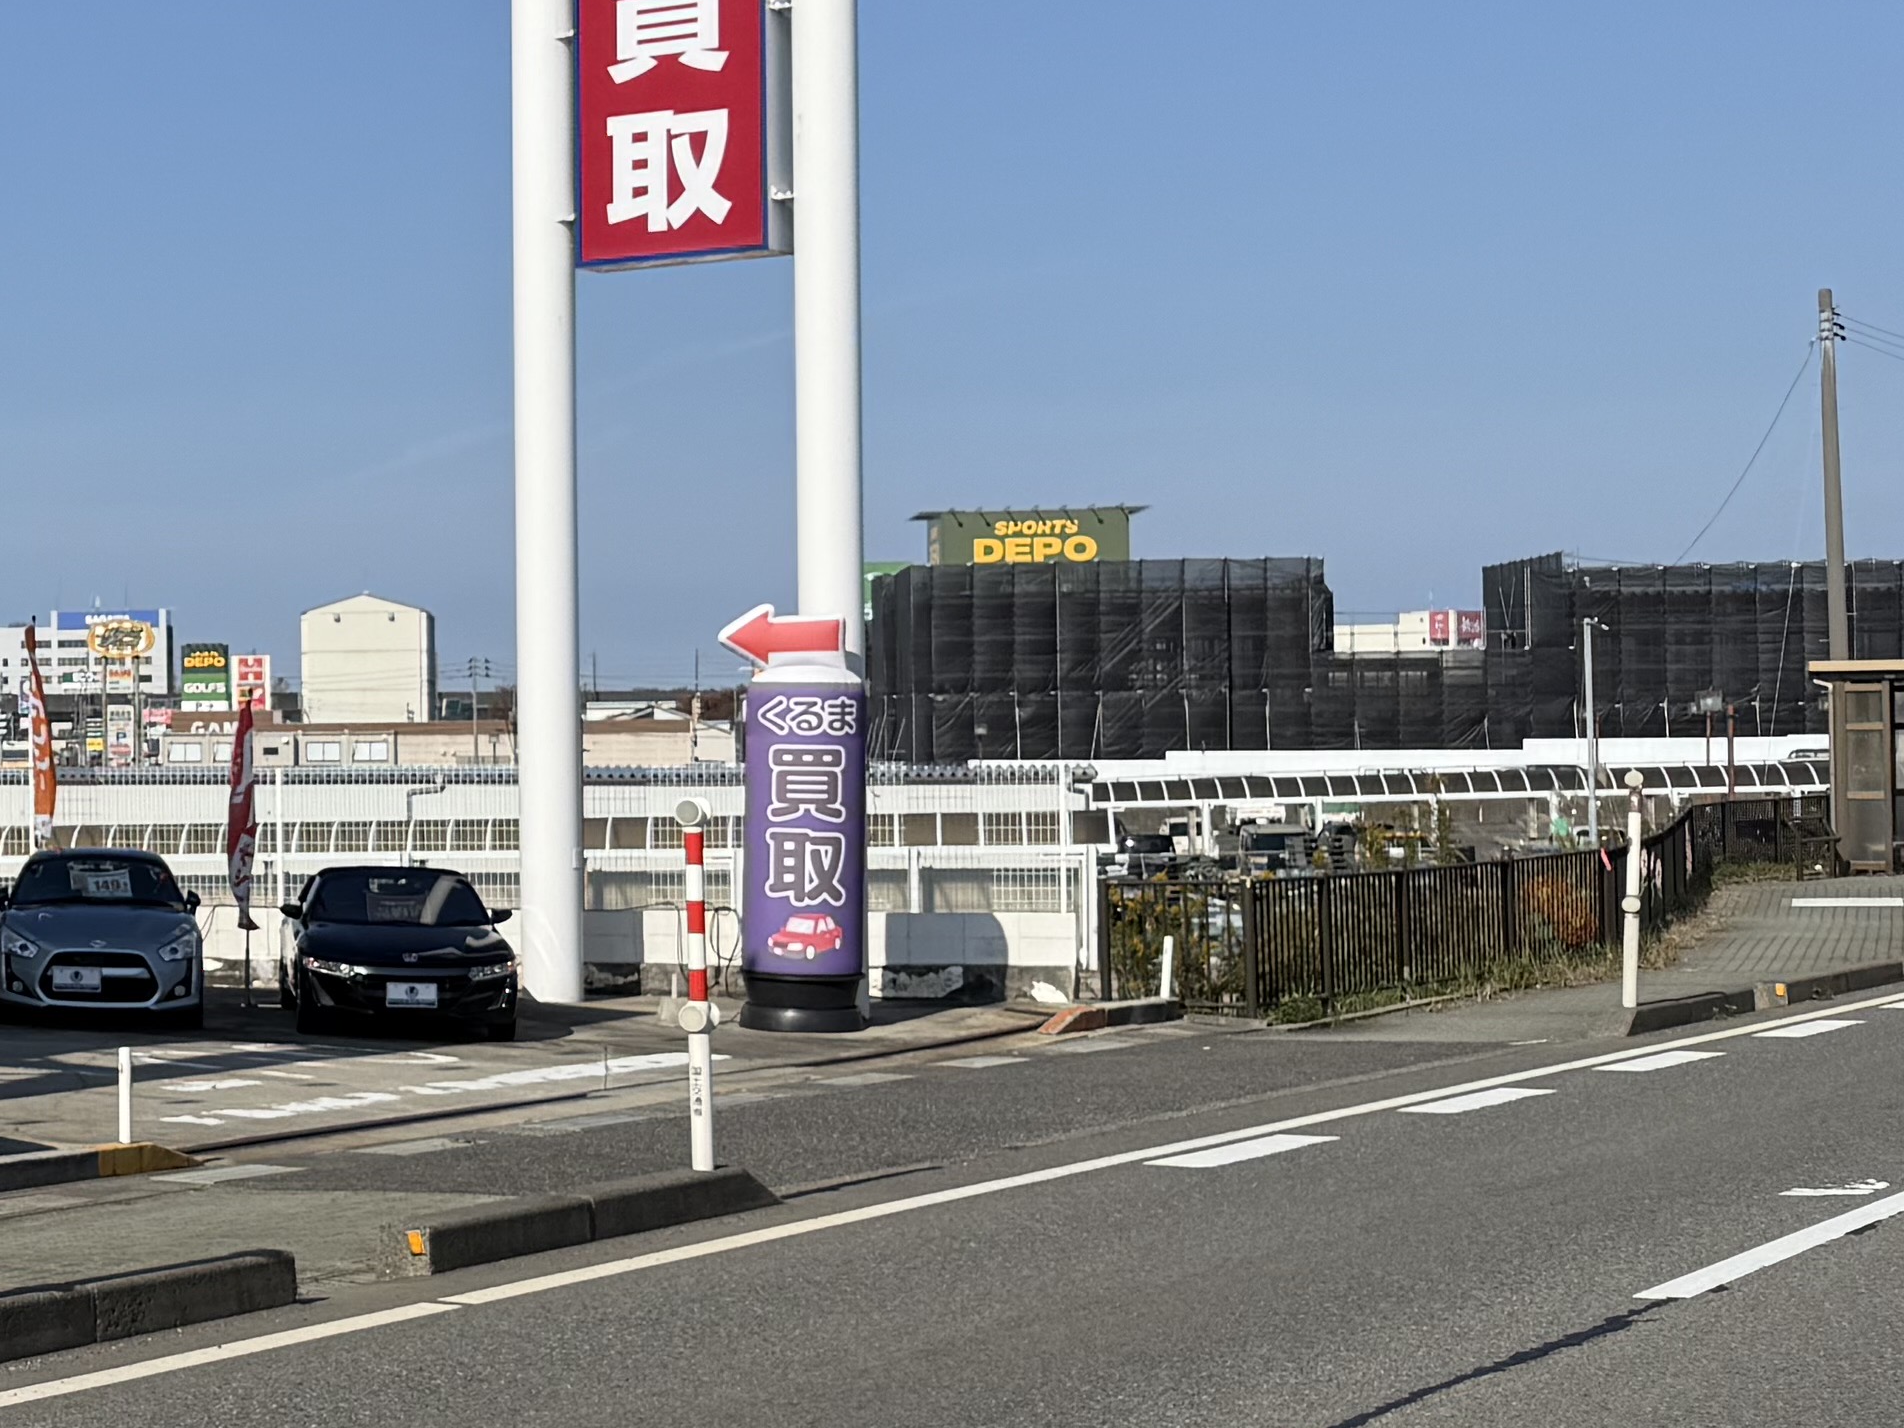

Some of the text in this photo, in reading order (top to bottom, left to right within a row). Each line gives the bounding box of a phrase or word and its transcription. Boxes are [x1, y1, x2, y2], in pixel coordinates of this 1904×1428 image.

[973, 535, 1098, 564] DEPO
[184, 657, 226, 668] DEPO
[757, 695, 857, 735] くるま
[764, 743, 846, 907] 買取
